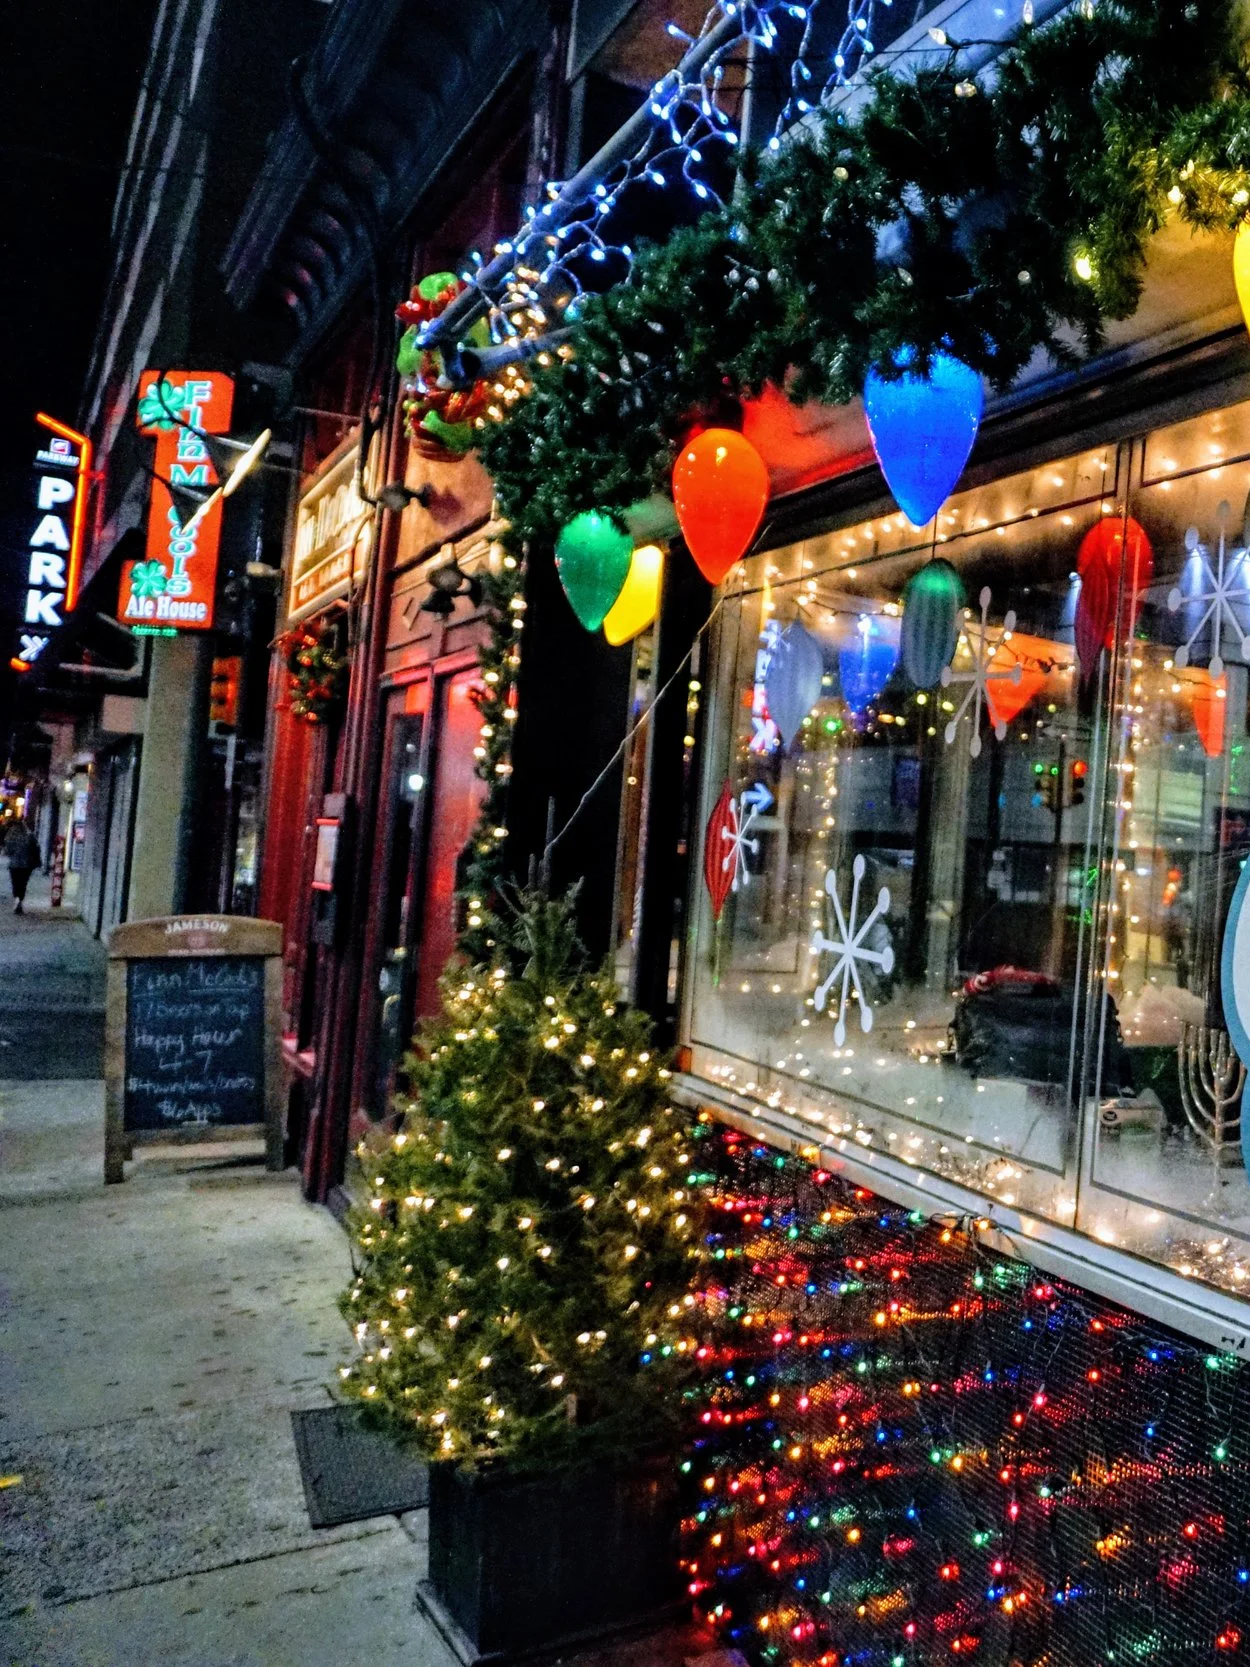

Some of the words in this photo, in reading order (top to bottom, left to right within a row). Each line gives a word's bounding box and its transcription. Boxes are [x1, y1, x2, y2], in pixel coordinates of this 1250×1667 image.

[36, 450, 80, 466] PARKWAY
[25, 475, 76, 626] PARK
[124, 594, 155, 618] Ale
[156, 596, 207, 620] House
[165, 919, 231, 934] JAMESON
[134, 1026, 185, 1055] Happy
[191, 1025, 242, 1046] Hour
